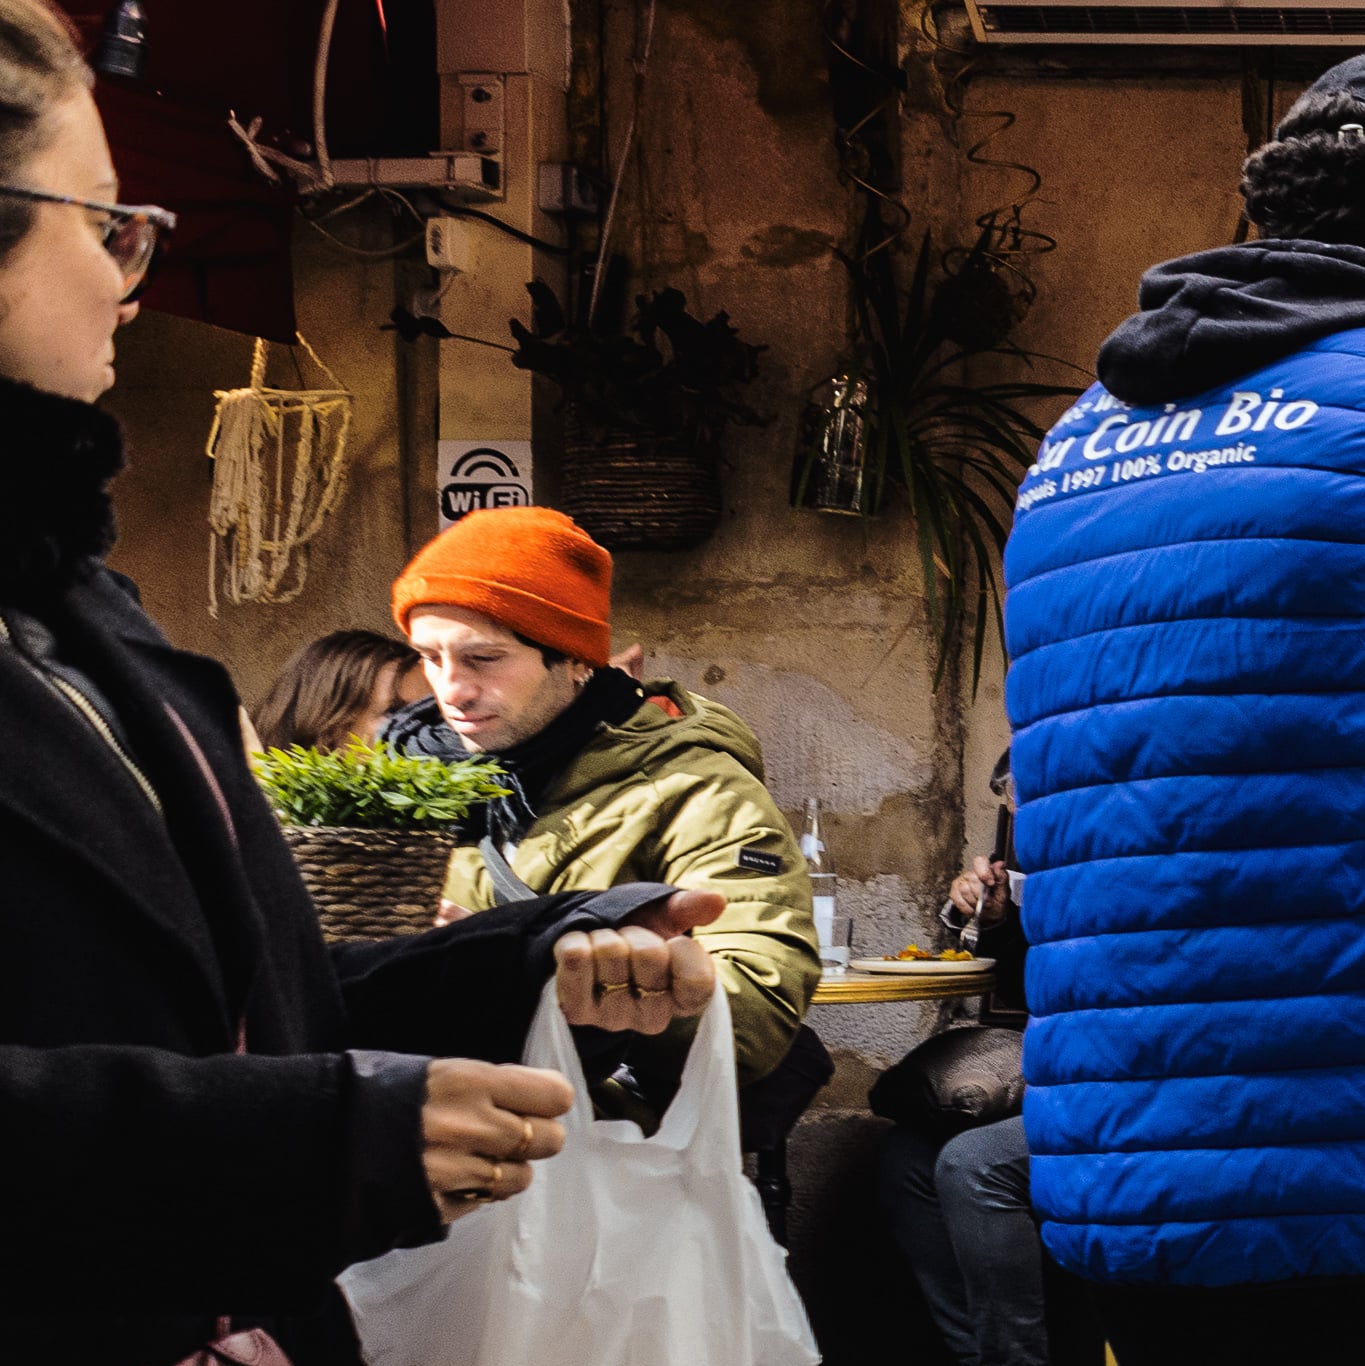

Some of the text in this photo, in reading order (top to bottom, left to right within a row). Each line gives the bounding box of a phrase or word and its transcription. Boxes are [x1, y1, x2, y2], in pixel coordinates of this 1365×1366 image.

[1083, 403, 1202, 460] Coin
[1215, 388, 1320, 436] Bio
[1062, 464, 1106, 493] 1997
[1112, 453, 1162, 483] 100%
[1167, 442, 1257, 474] Organic
